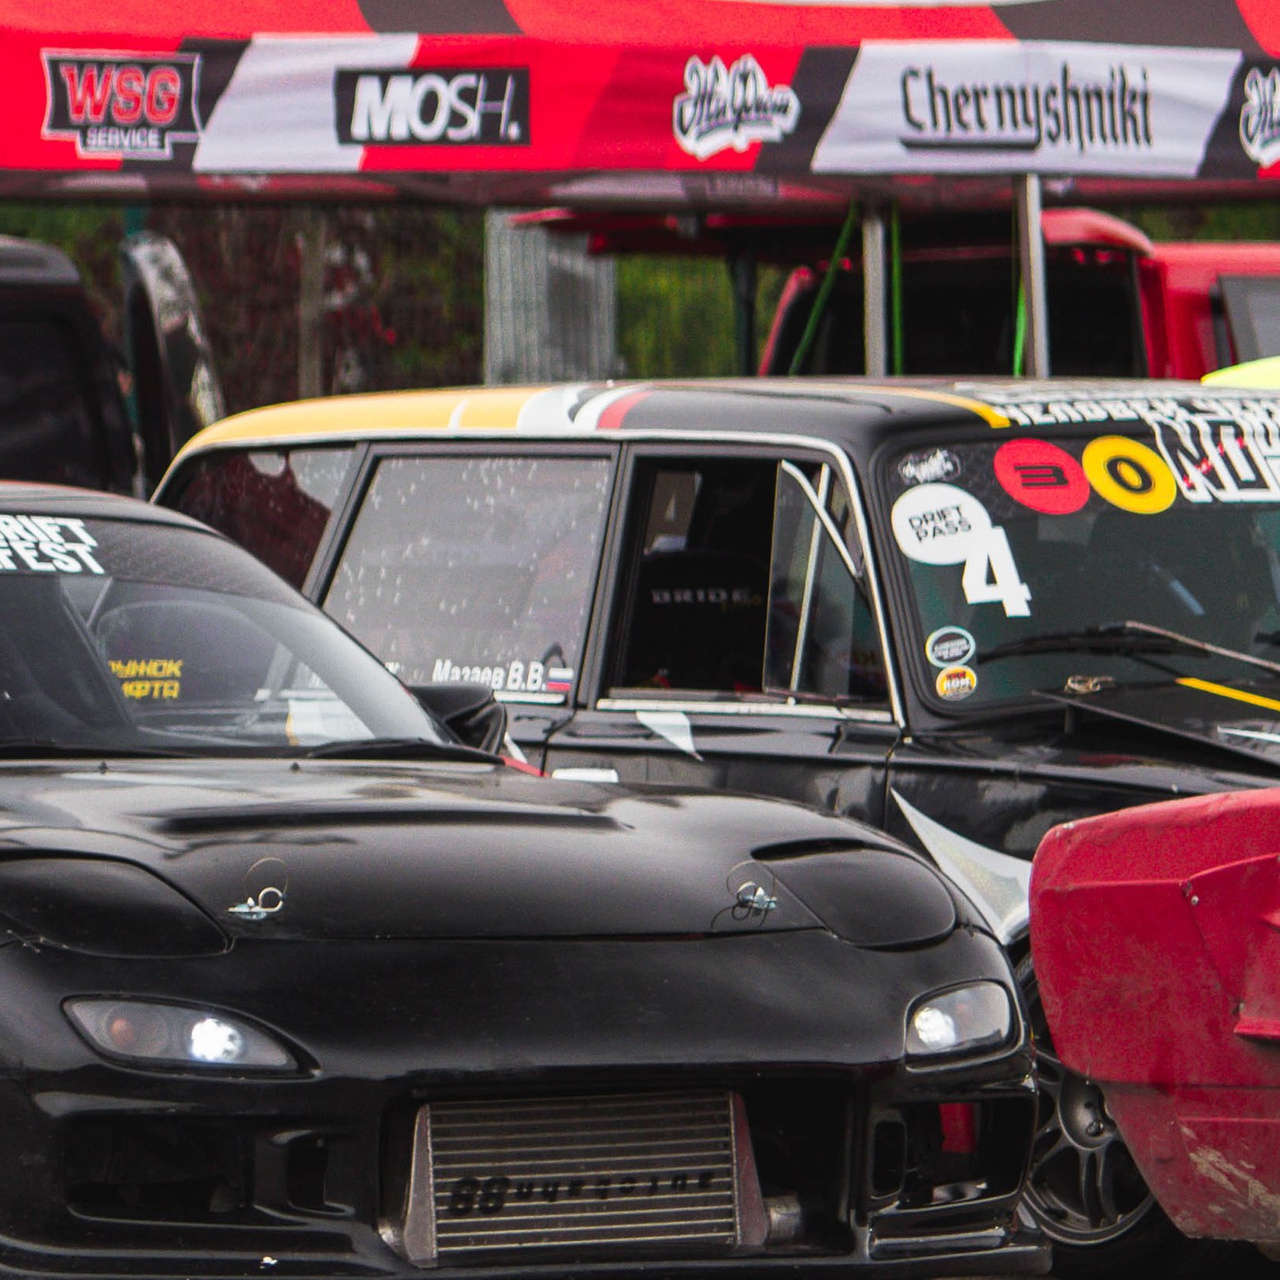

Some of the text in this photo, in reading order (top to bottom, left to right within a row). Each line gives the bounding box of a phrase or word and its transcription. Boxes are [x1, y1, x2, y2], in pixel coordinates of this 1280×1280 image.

[58, 62, 182, 126] WSG
[899, 60, 1154, 155] Chernyshniki
[85, 125, 161, 149] SERVICE
[908, 504, 964, 532] DRIFT
[915, 519, 971, 542] PASS
[962, 525, 1032, 617] 4
